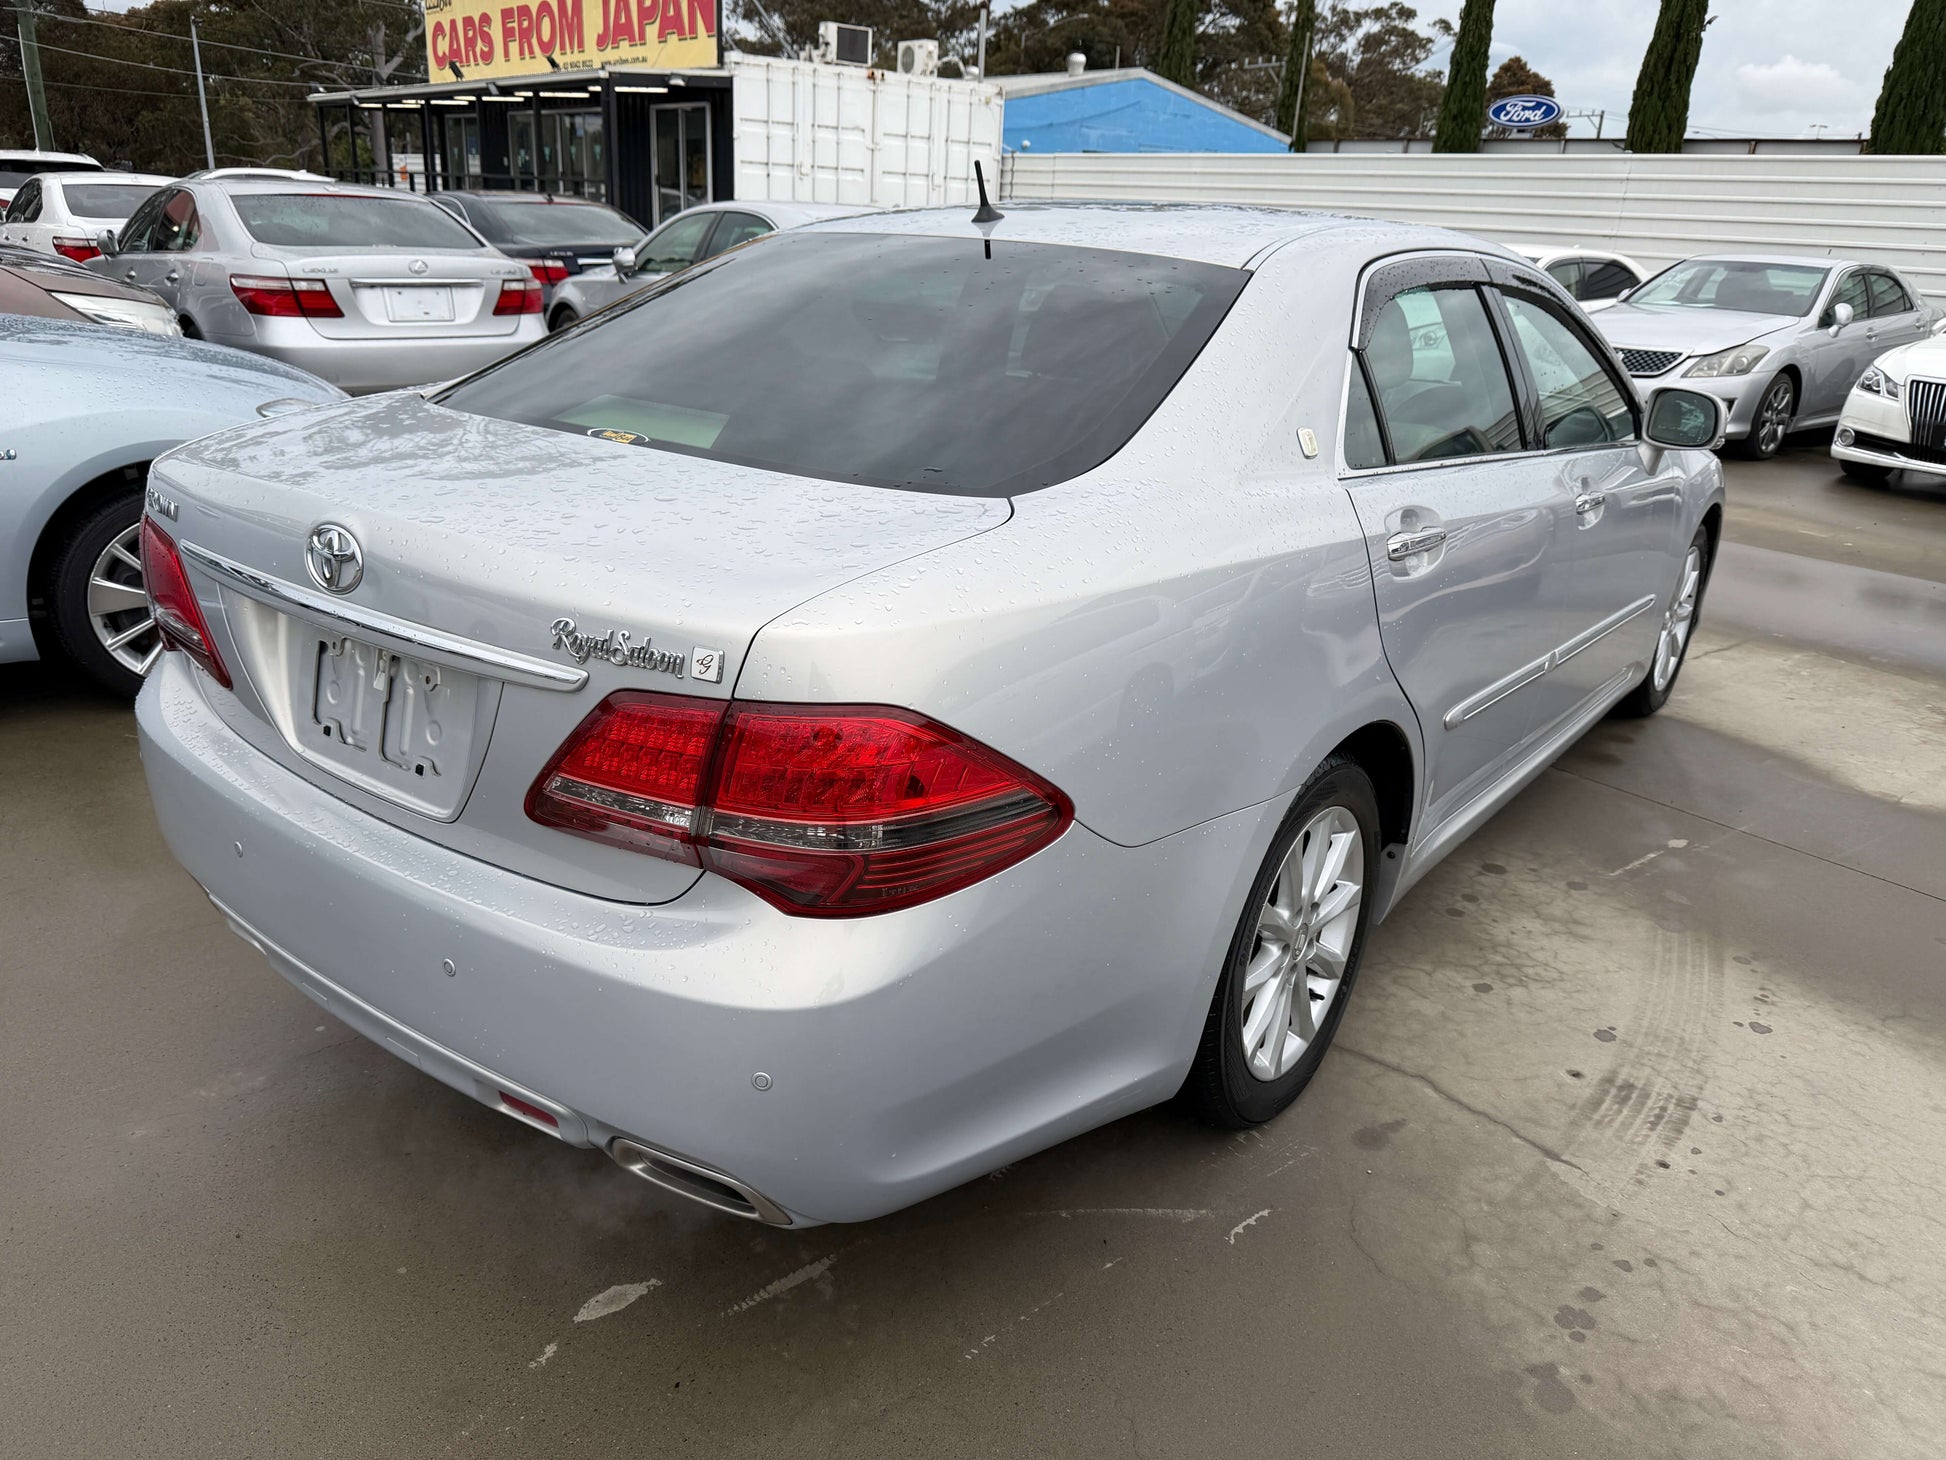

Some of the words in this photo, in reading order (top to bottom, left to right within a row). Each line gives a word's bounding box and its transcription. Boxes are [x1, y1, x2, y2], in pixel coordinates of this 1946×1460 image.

[432, 12, 495, 70] CARS
[501, 0, 585, 62] FROM
[596, 0, 716, 51] JAPAN
[1500, 101, 1547, 121] Ford
